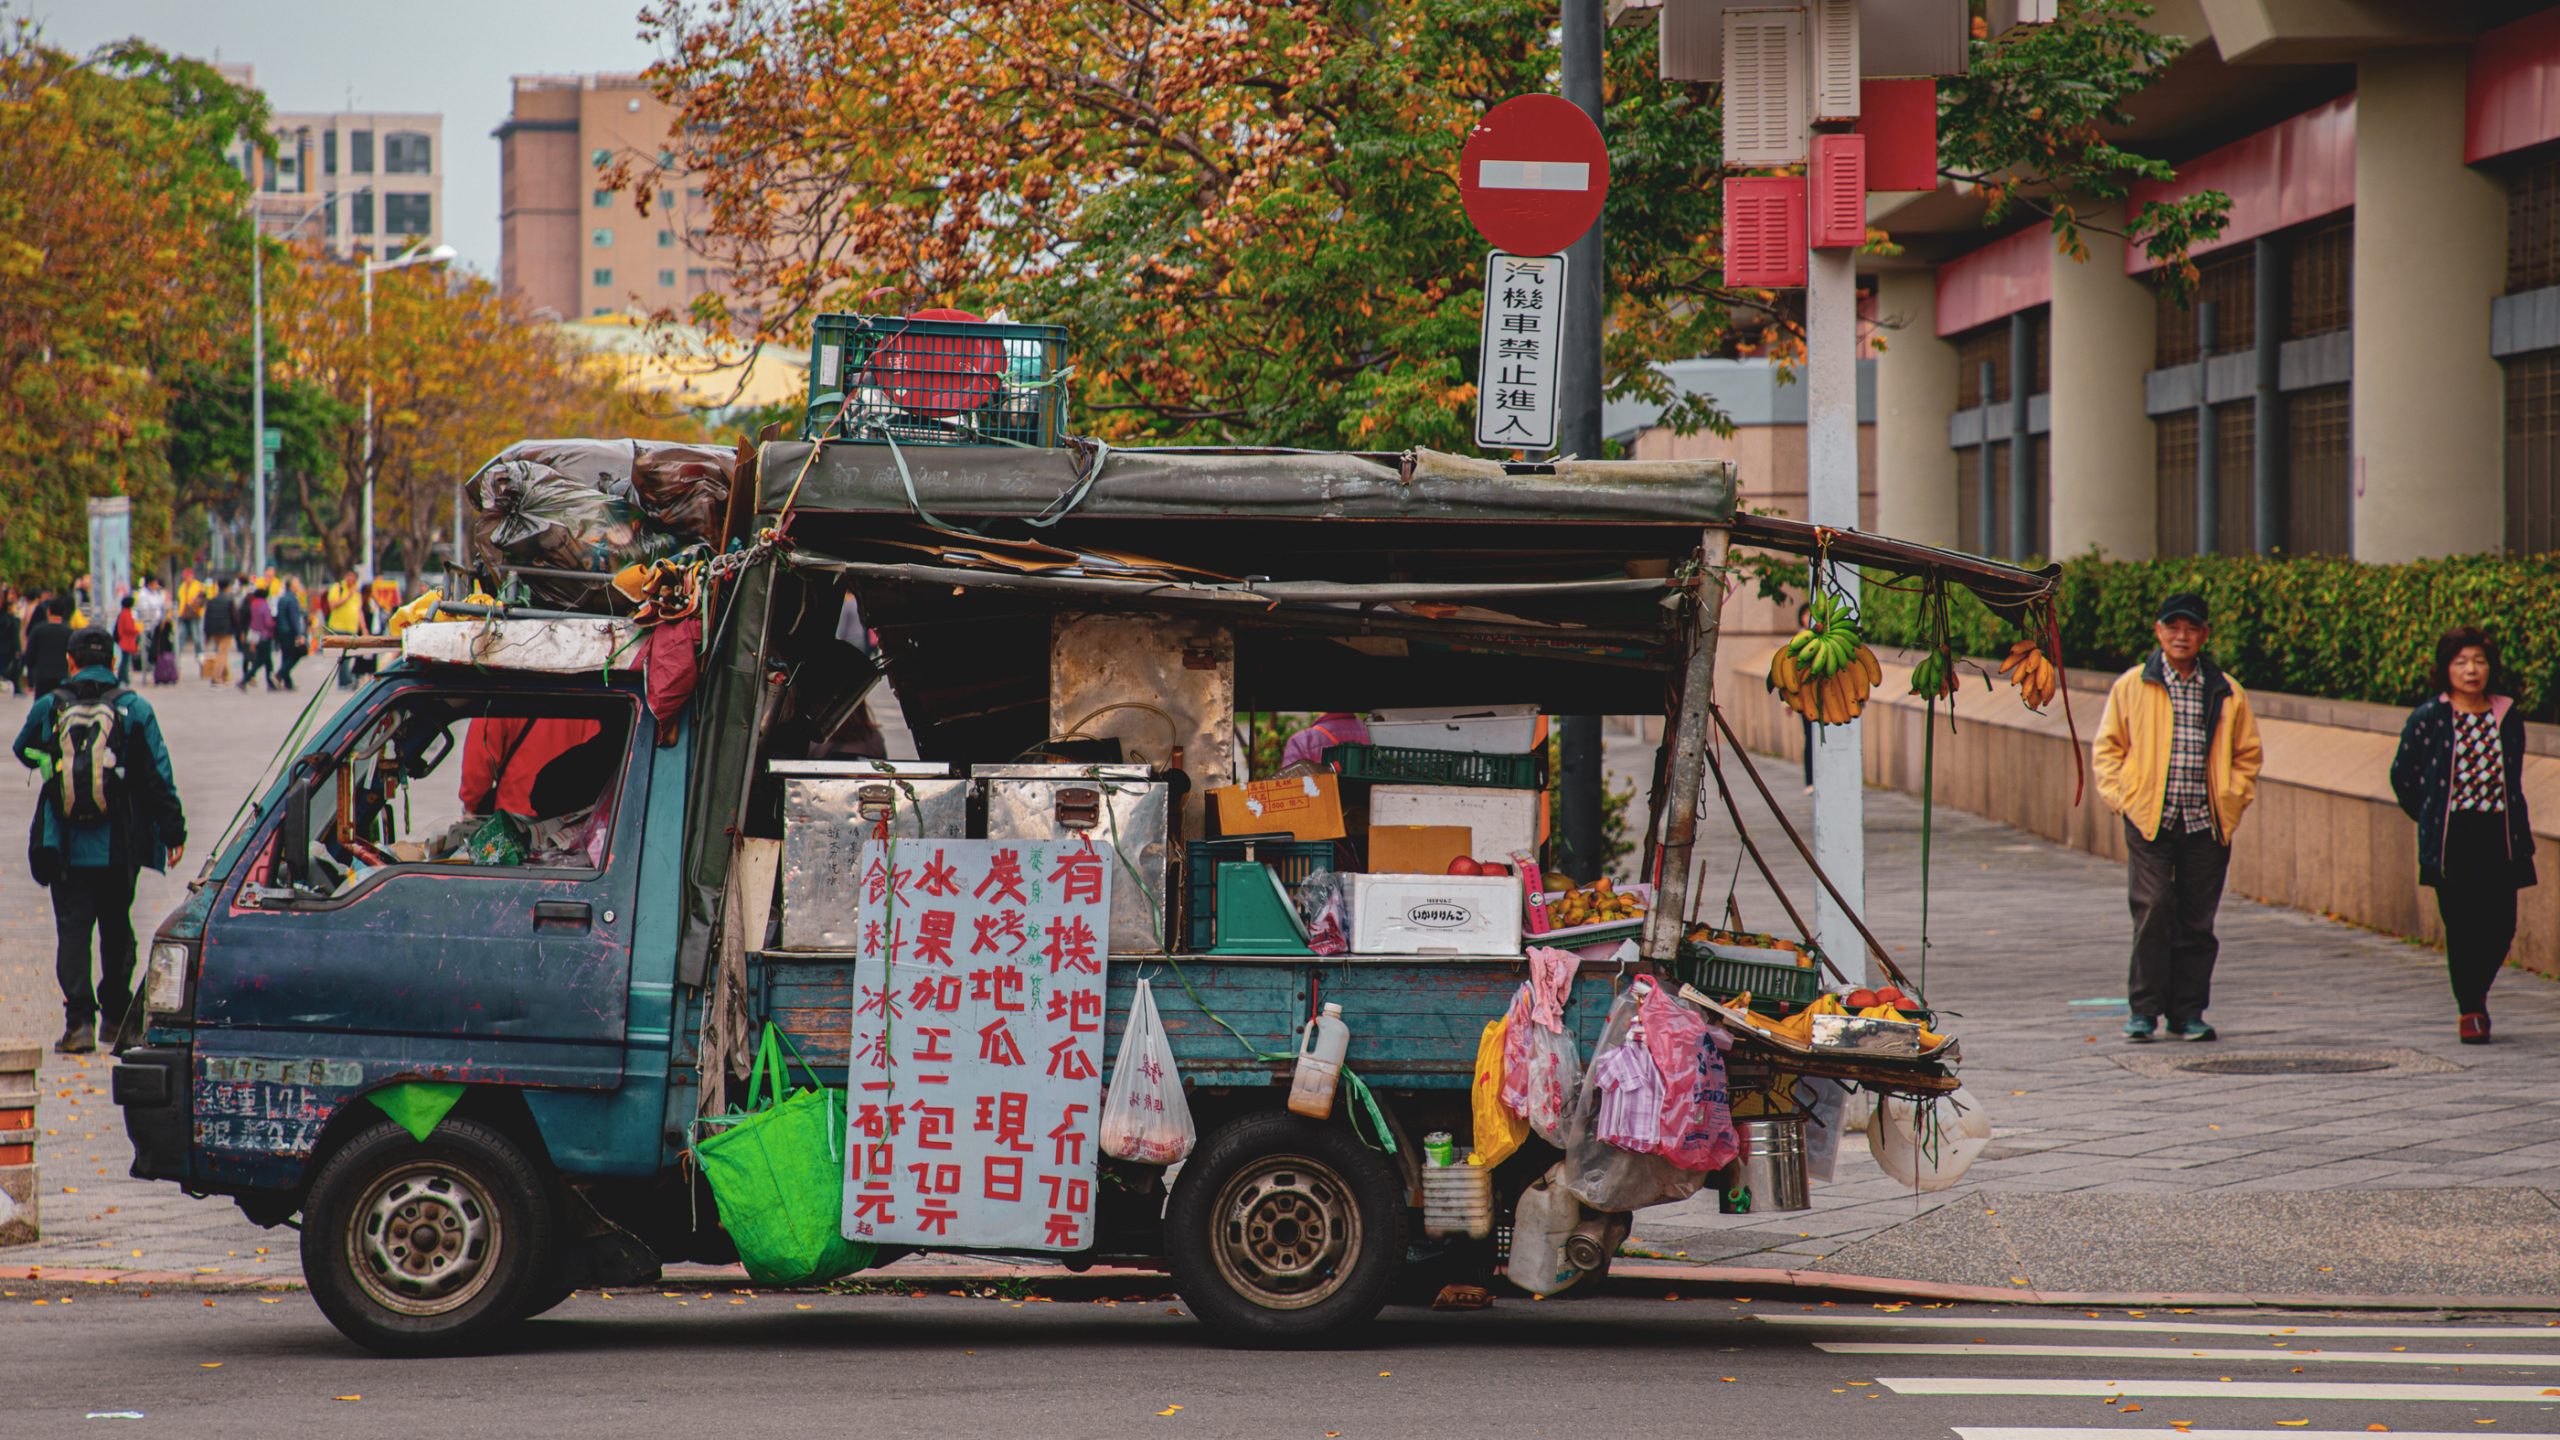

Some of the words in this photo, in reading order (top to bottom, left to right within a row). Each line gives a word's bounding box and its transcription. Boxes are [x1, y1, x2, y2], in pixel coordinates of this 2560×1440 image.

[1495, 262, 1544, 437] 汽機車禁止進入
[1411, 908, 1467, 922] いかりりんご
